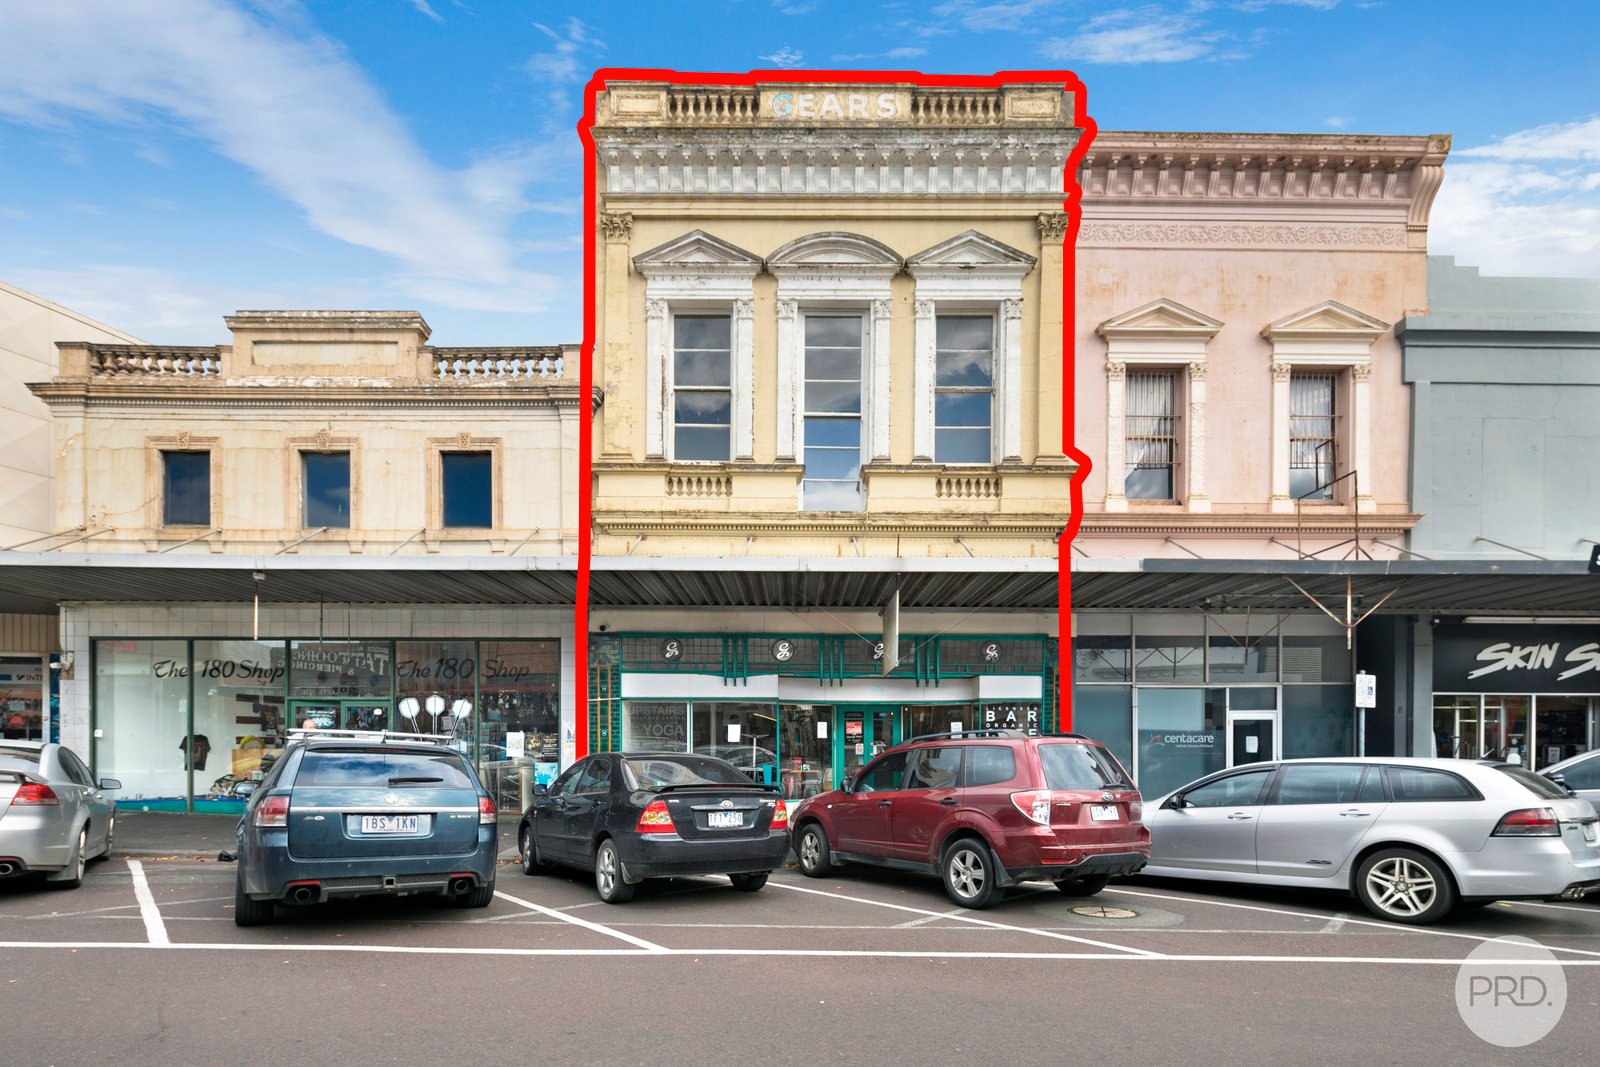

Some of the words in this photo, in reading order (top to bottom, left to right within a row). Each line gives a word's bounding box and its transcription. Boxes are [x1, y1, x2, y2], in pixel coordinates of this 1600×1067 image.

[772, 91, 898, 119] GEARS
[396, 659, 430, 678] The
[434, 657, 475, 679] 180
[482, 659, 530, 682] Shop
[1467, 642, 1560, 680] SKIN
[1556, 642, 1600, 681] S
[153, 659, 189, 679] The
[201, 659, 235, 679] 180
[236, 659, 286, 684] Shop
[986, 711, 1037, 722] BAR
[643, 724, 685, 736] YOGA
[1164, 732, 1214, 743] centacare
[365, 817, 386, 829] 1BS
[396, 817, 416, 829] 1KN
